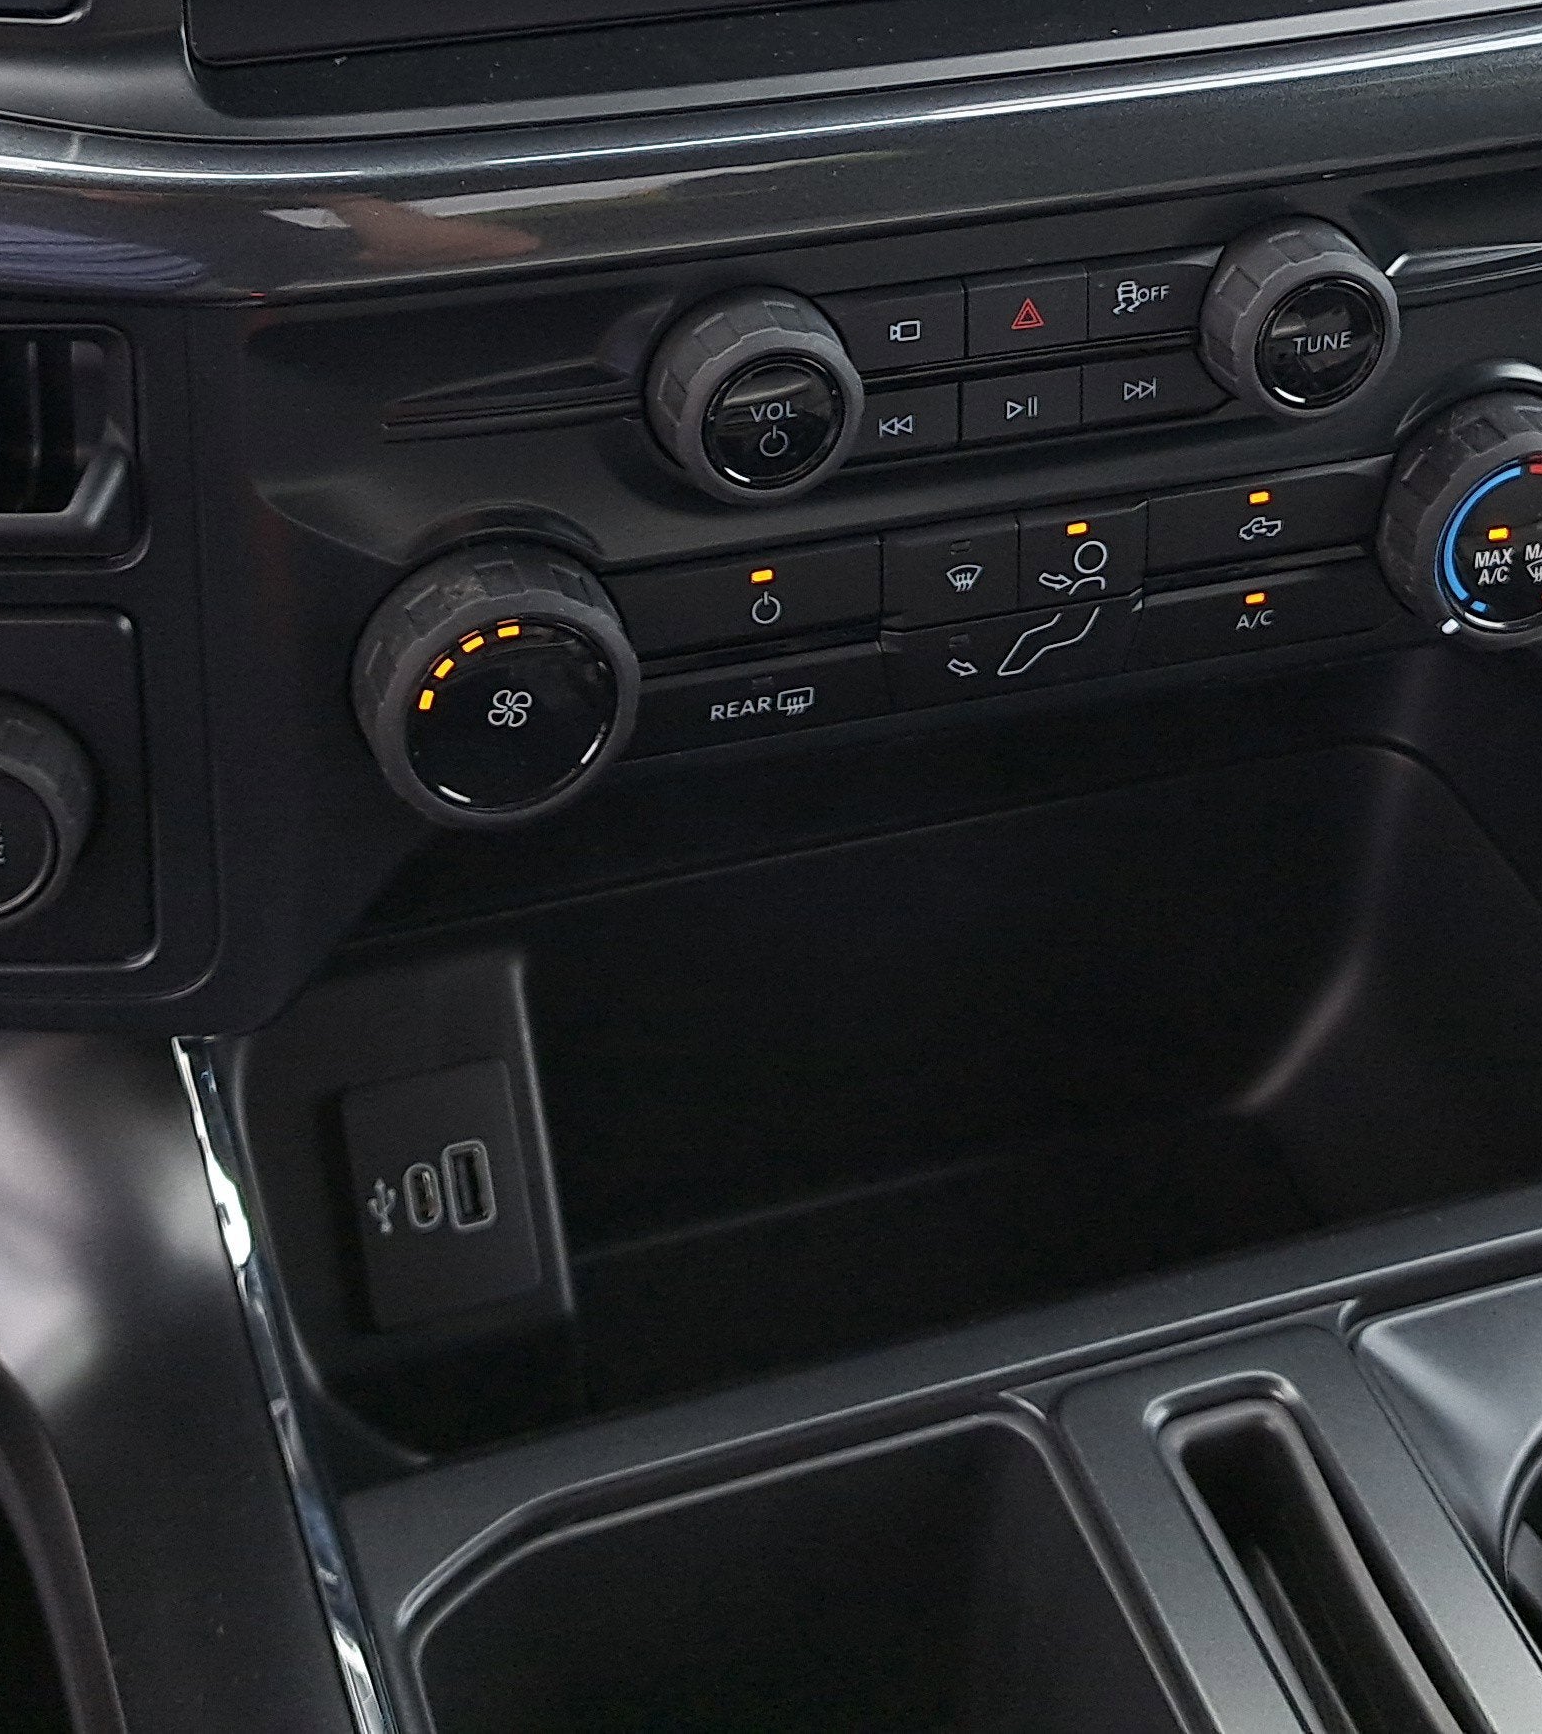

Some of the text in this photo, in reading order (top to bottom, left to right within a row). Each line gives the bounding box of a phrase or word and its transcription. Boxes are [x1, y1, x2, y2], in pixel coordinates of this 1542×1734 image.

[1138, 284, 1170, 304] OFF
[1293, 330, 1352, 354] TUNE
[750, 401, 798, 423] VOL
[1474, 546, 1513, 568] MAX
[1478, 566, 1511, 584] A/C
[1236, 609, 1274, 631] A/C
[710, 695, 772, 722] REAR
